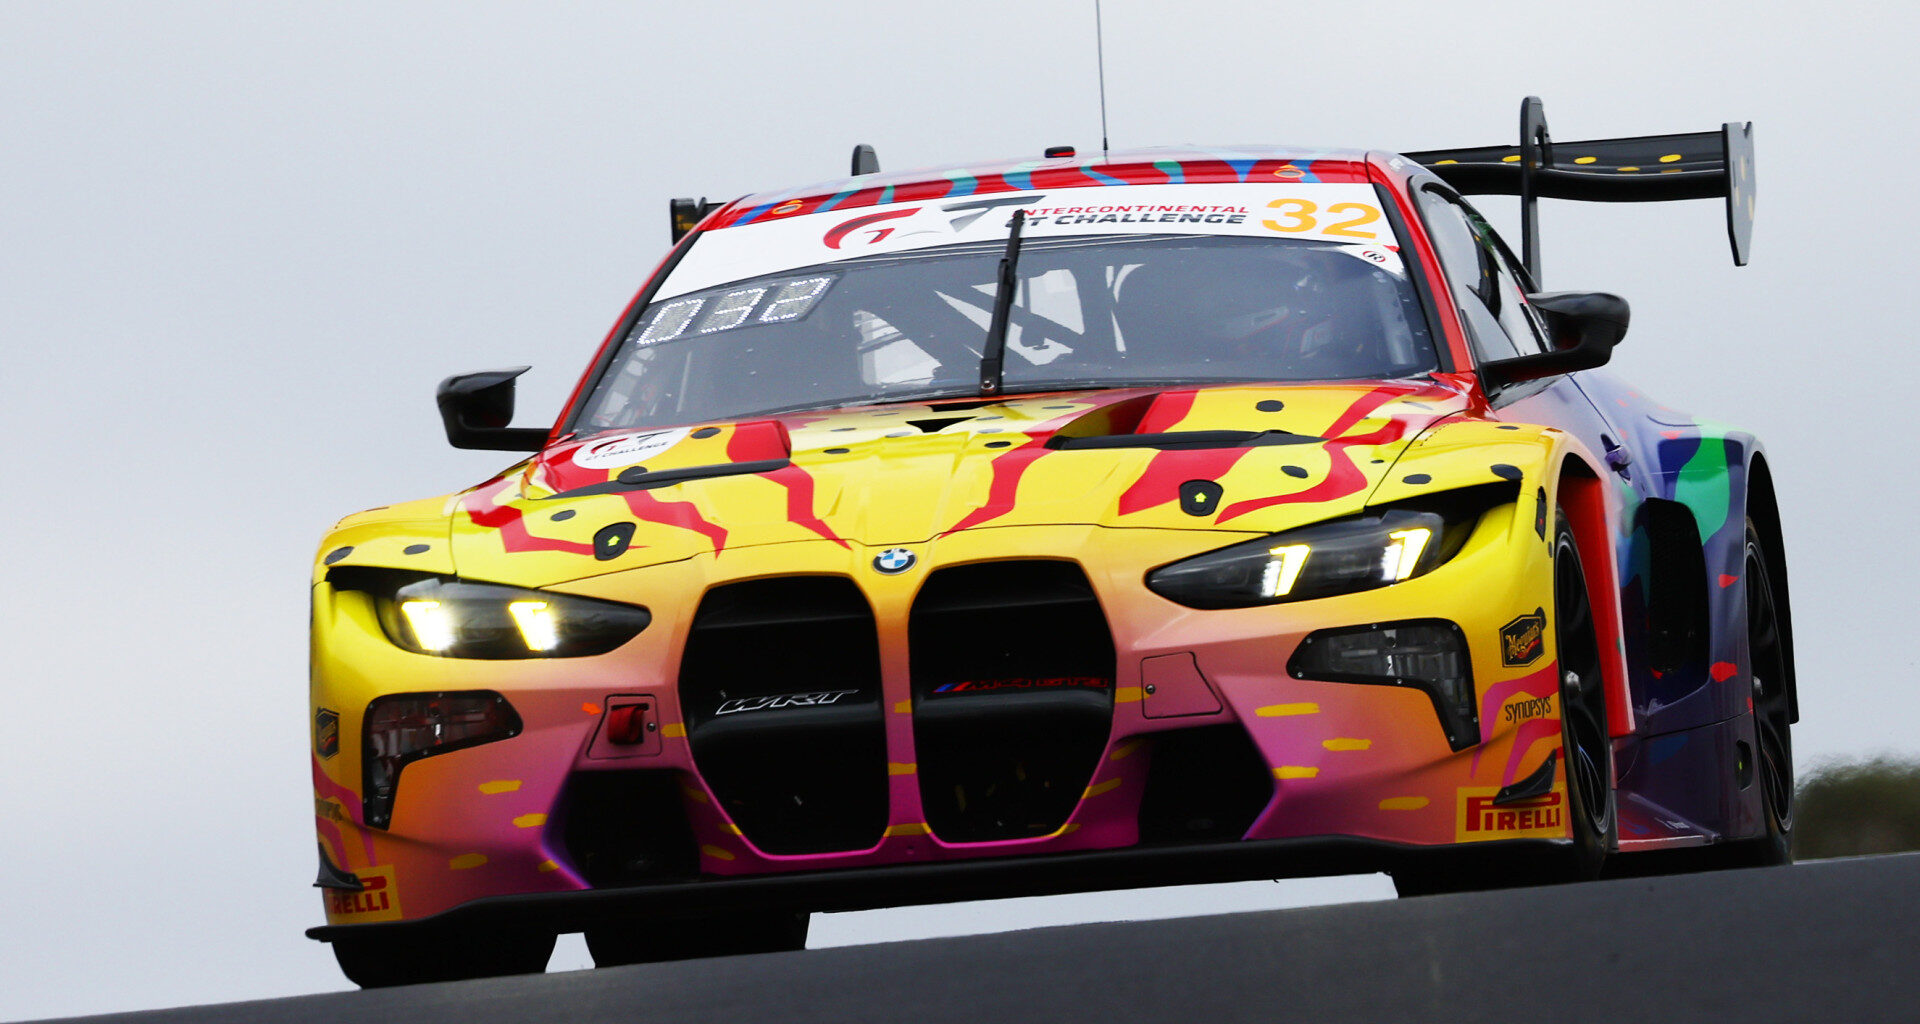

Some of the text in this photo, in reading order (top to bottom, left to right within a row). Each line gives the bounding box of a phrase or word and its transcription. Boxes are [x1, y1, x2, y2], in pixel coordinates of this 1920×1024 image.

[1012, 205, 1249, 217] NTERCONTINENTAL
[1055, 213, 1247, 225] CHALLENGE
[1262, 198, 1381, 239] 32
[636, 277, 831, 345] 032
[715, 688, 860, 716] WRT
[1505, 696, 1552, 724] SYNOPSYS
[1466, 792, 1561, 831] PIRELLI
